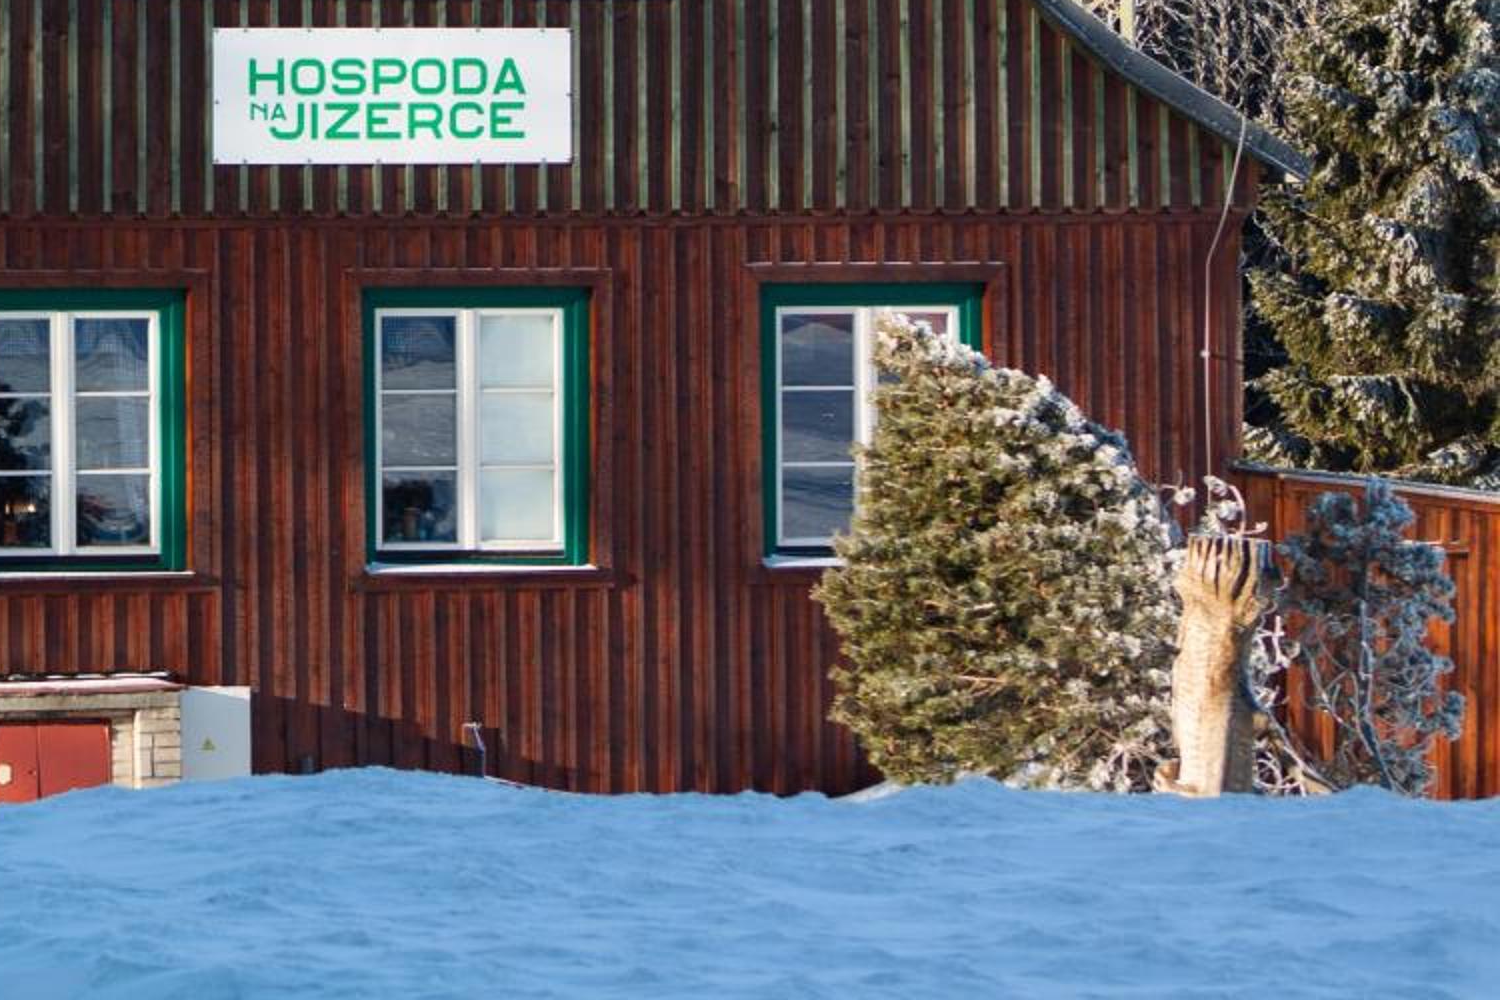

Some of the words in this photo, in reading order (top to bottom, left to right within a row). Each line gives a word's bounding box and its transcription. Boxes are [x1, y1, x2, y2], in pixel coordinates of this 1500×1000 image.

[247, 57, 527, 97] HOSPODA
[249, 102, 287, 121] NA
[268, 101, 526, 141] JIZERCE
